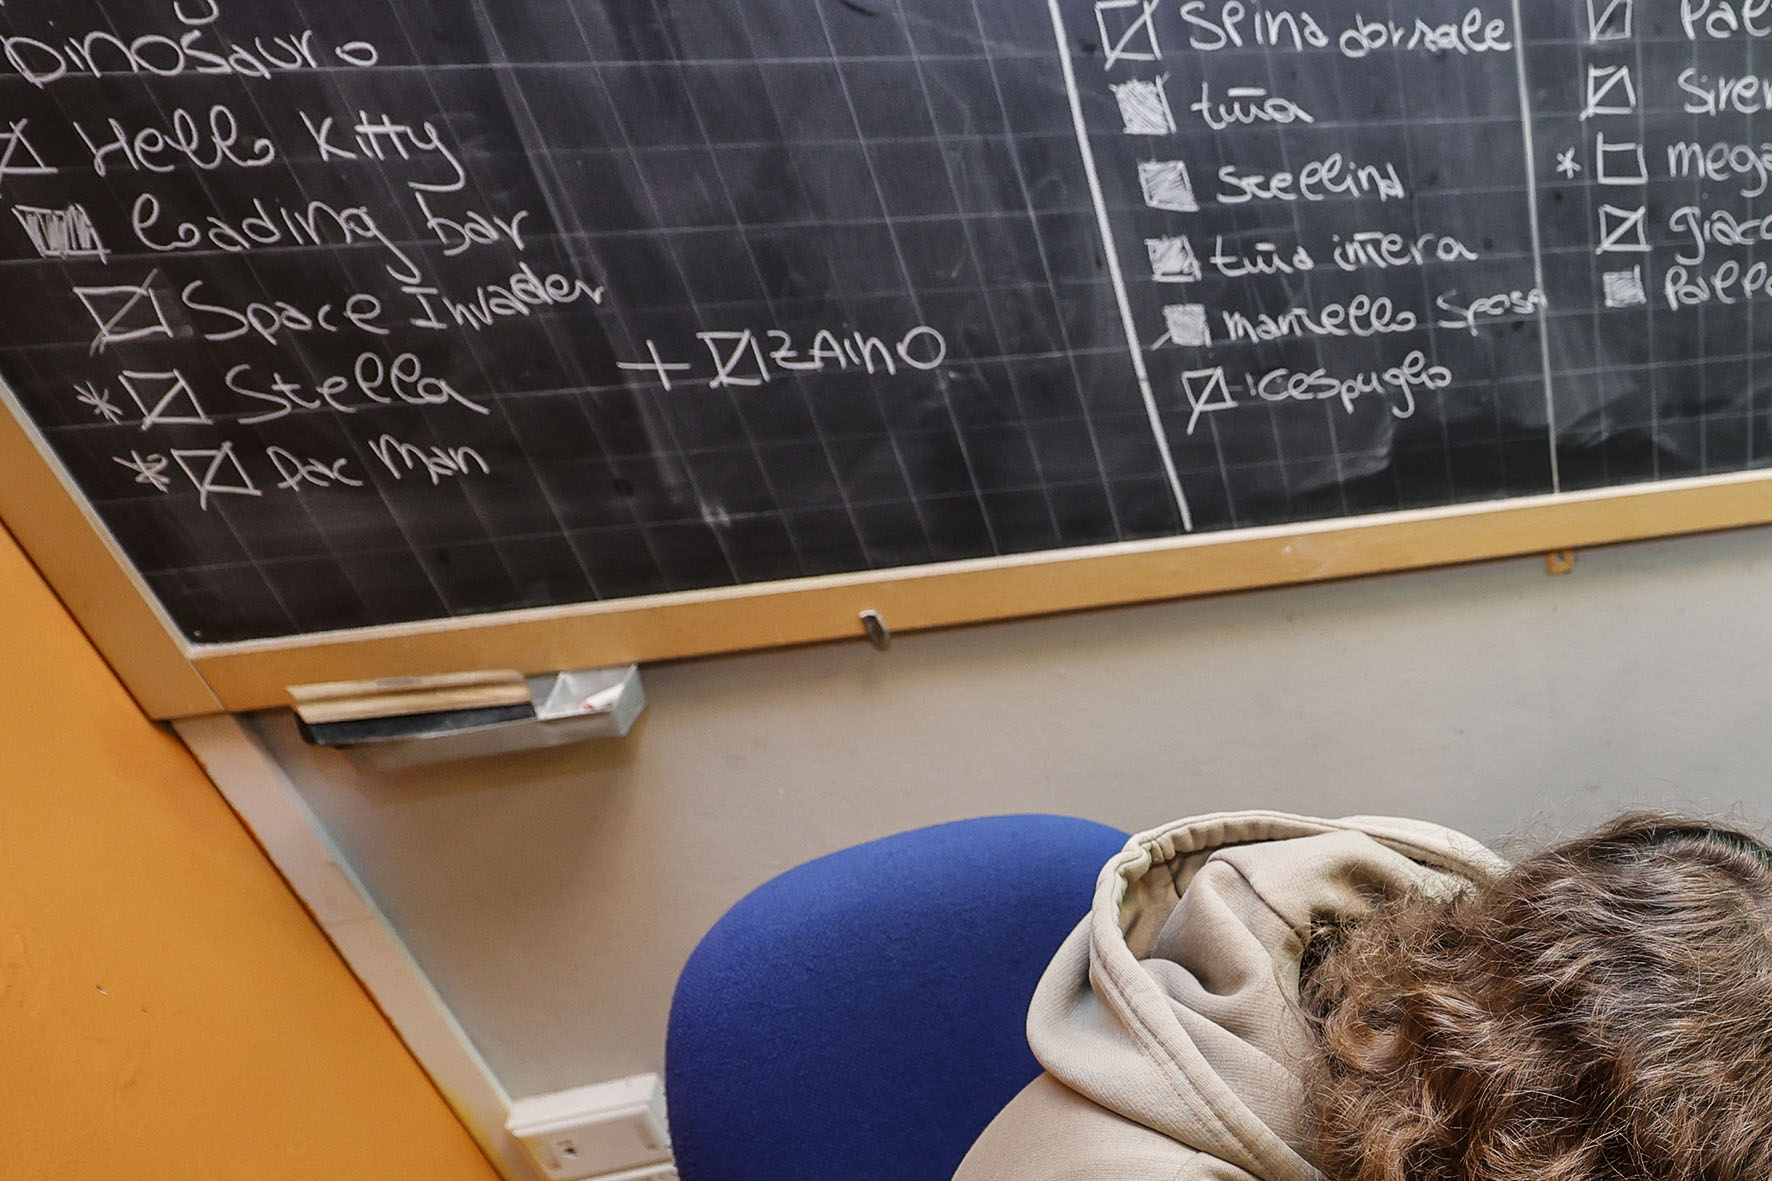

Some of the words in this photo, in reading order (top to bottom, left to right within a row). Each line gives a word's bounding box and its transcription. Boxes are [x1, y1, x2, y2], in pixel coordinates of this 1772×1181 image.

[0, 30, 378, 88] Dinosauro
[73, 105, 275, 177] Hello
[299, 110, 466, 192] Kitty
[132, 193, 423, 284] loading
[415, 192, 528, 257] bar
[181, 281, 390, 345] Space
[408, 262, 606, 332] Invader
[225, 352, 490, 426] Stella
[371, 434, 490, 485] Man
